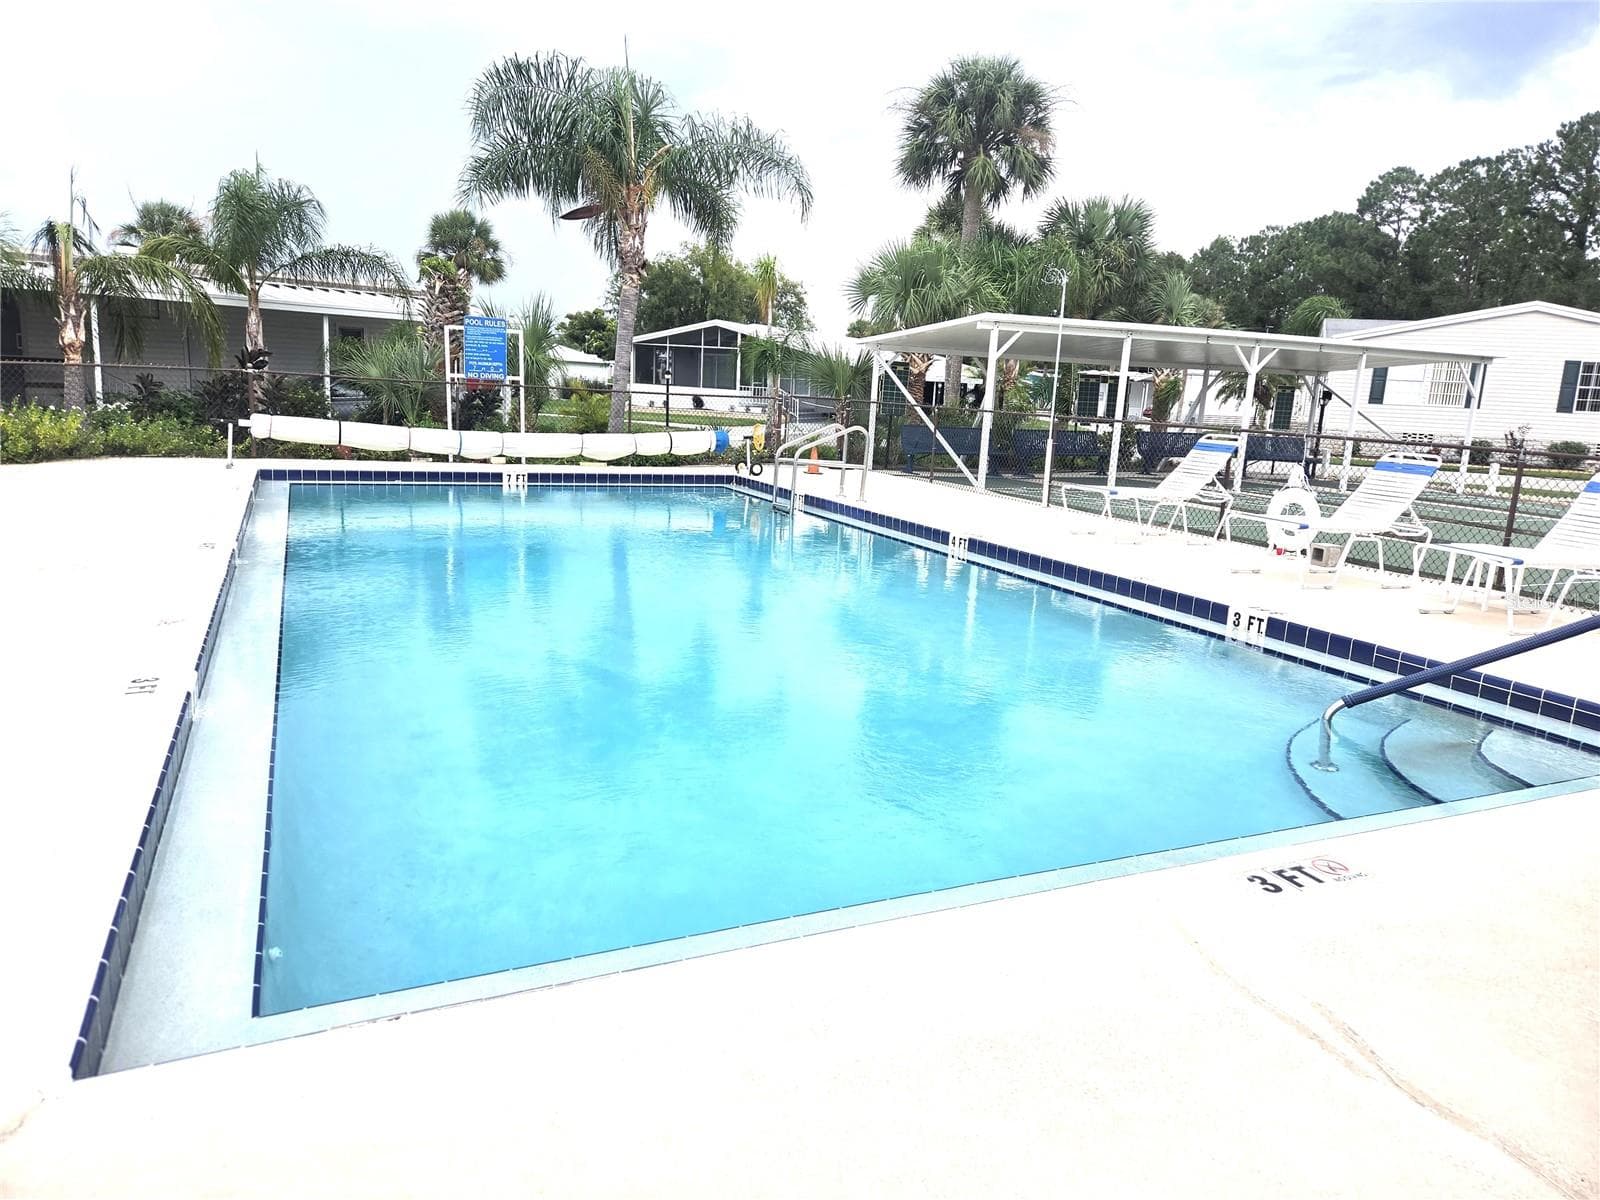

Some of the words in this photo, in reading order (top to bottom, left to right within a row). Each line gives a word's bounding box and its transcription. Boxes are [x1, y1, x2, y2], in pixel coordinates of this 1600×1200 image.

[465, 318, 484, 326] POOL
[484, 319, 506, 328] RULES
[480, 372, 505, 380] DIVING
[506, 474, 512, 482] 7
[516, 474, 526, 482] FT
[951, 536, 956, 547] 4
[959, 538, 967, 550] FT
[1232, 611, 1241, 627] 3
[1247, 615, 1265, 635] FT.
[1246, 875, 1283, 893] 3
[1271, 865, 1326, 888] FT
